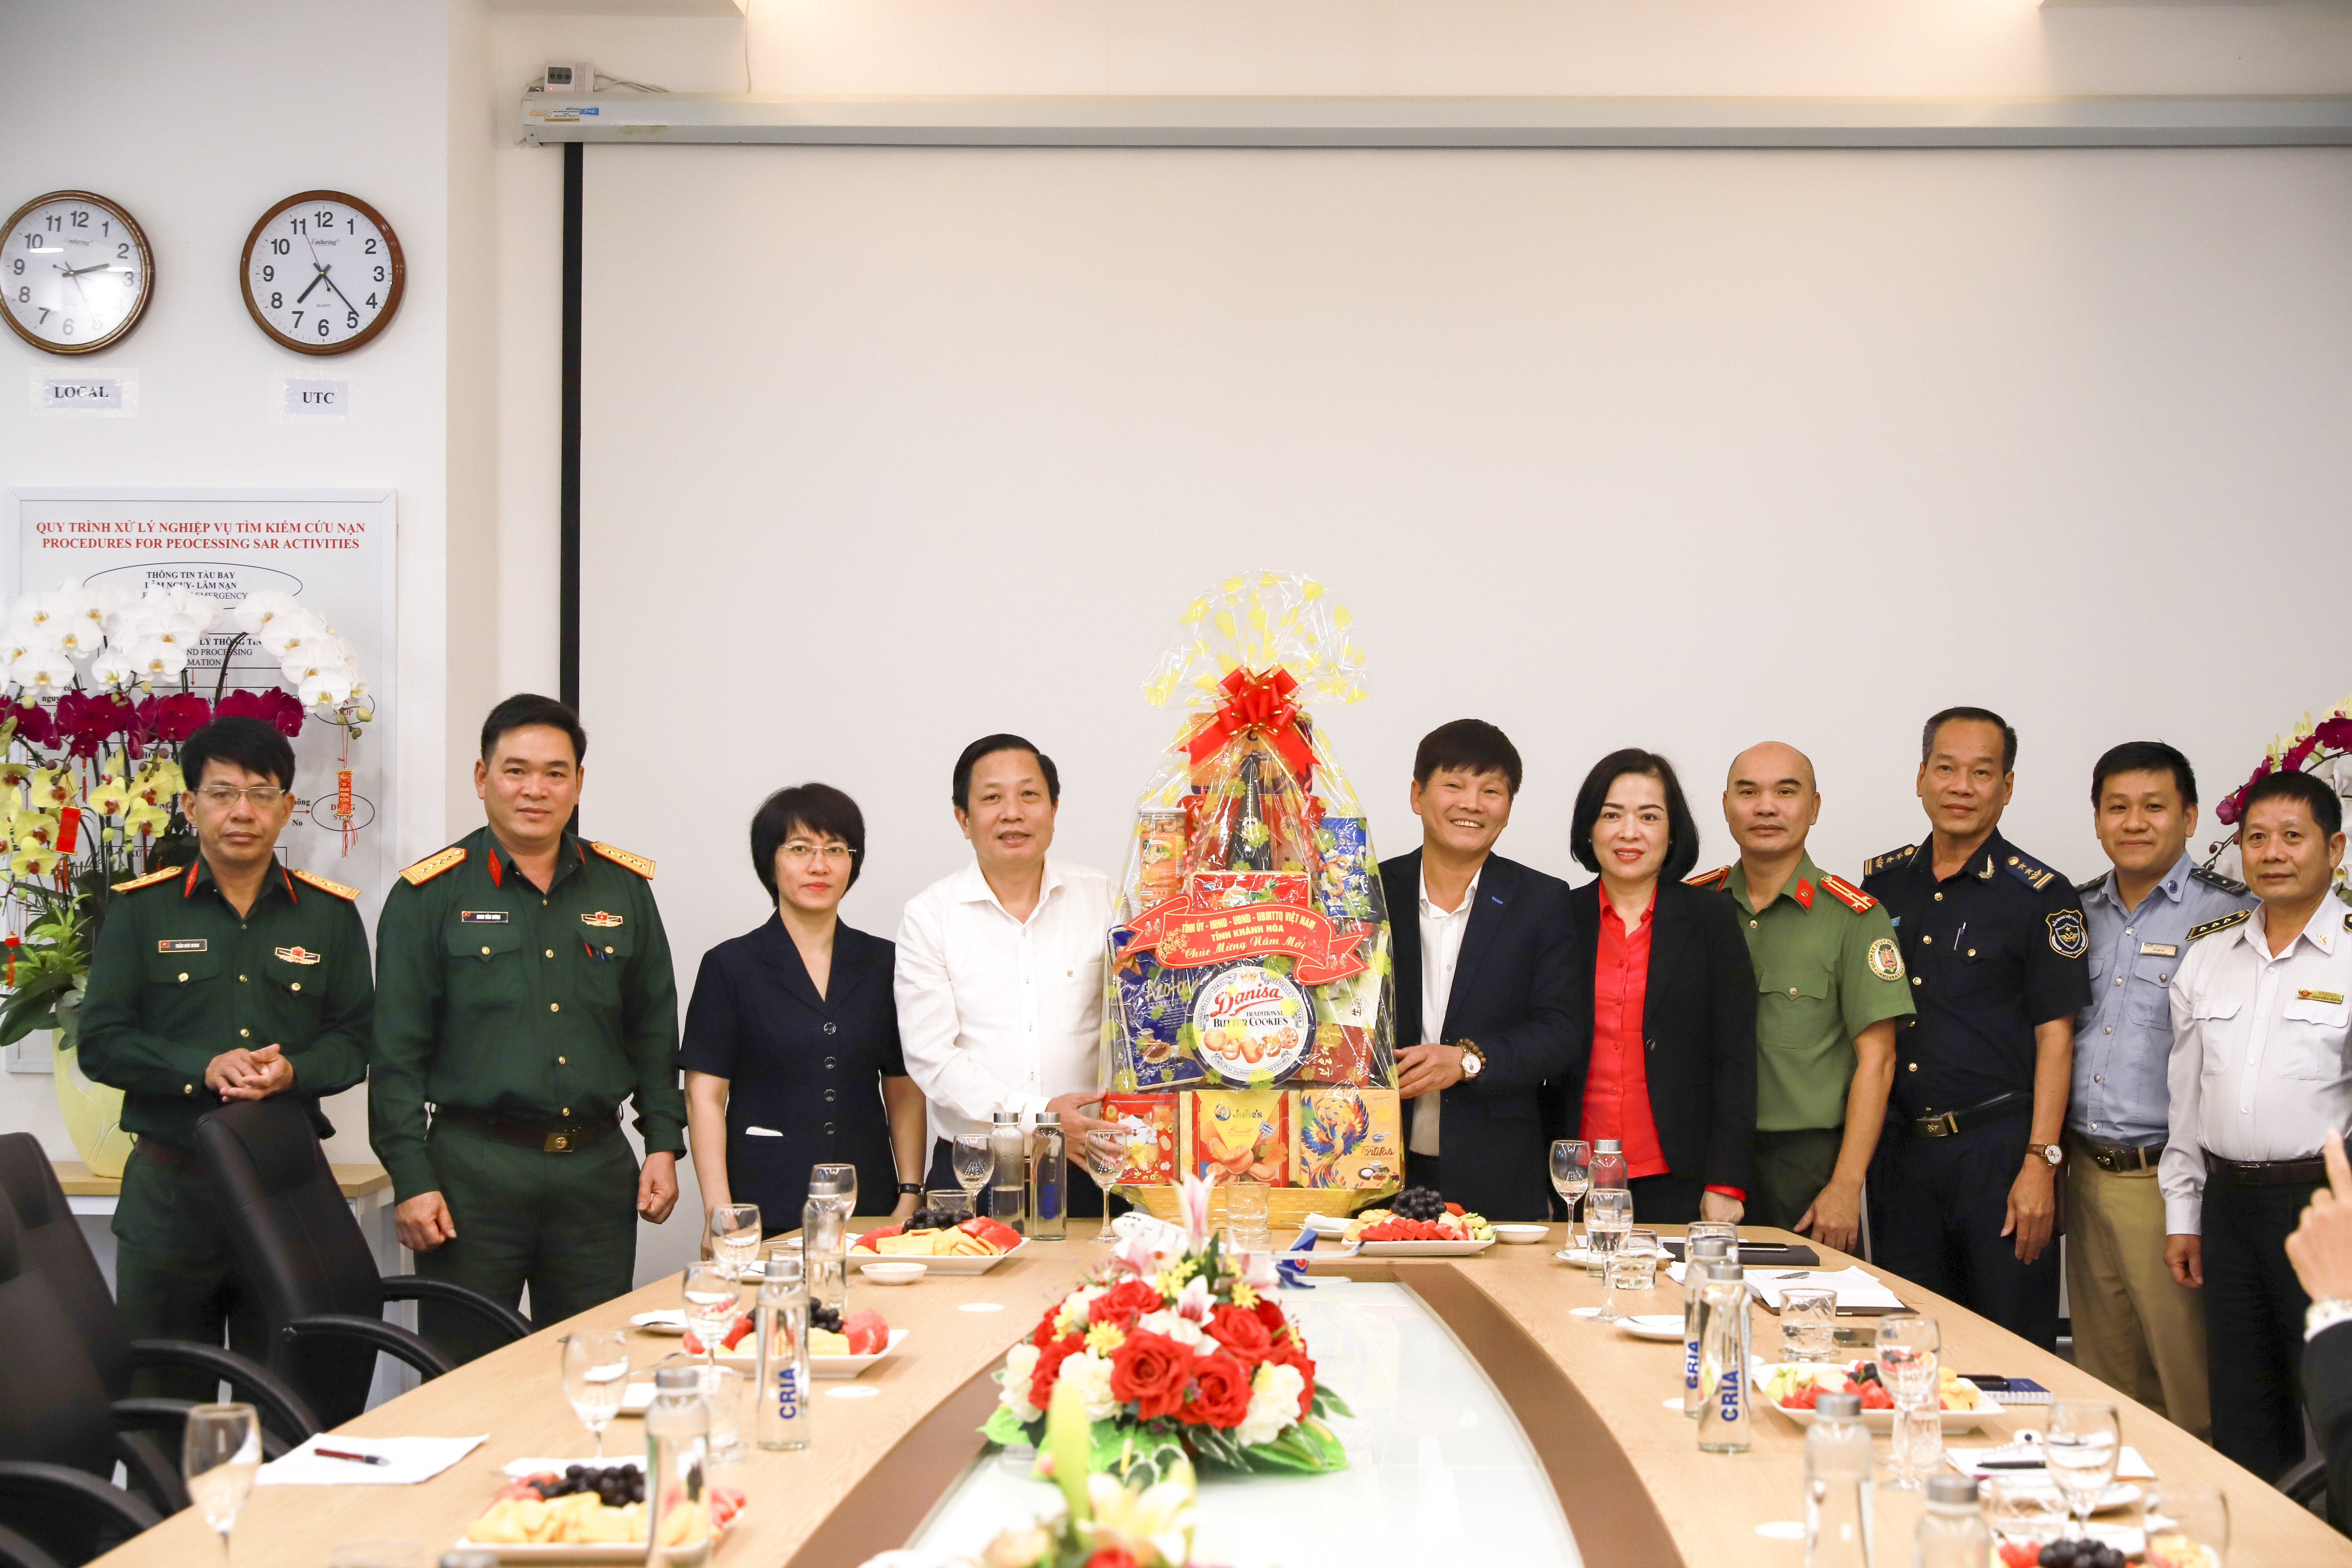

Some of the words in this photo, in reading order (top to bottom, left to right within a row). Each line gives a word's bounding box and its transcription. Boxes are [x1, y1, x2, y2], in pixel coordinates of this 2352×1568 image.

[46, 215, 61, 232] 11
[70, 211, 89, 228] 12
[291, 219, 306, 234] 11
[314, 211, 333, 227] 12
[347, 219, 354, 234] 1
[103, 221, 109, 237] 1
[25, 233, 43, 249] 10
[271, 239, 290, 254] 10
[365, 239, 376, 254] 2
[117, 243, 129, 259] 2
[14, 259, 25, 275] 9
[263, 265, 274, 282] 9
[374, 266, 384, 282] 3
[123, 272, 134, 287] 3
[19, 286, 31, 303] 8
[271, 292, 283, 309] 8
[366, 292, 377, 309] 4
[39, 307, 50, 324] 7
[92, 314, 104, 331] 5
[292, 311, 304, 328] 7
[347, 311, 358, 328] 5
[63, 318, 74, 335] 6
[318, 319, 329, 337] 6
[54, 386, 109, 399] LOCAL
[302, 392, 334, 404] UTC
[37, 522, 65, 534] QUY
[69, 519, 111, 532] TRÌNH
[115, 519, 135, 532] XỬ
[138, 519, 156, 532] LÝ
[159, 521, 210, 535] NGHIỆP
[214, 522, 232, 535] VỤ
[236, 520, 262, 533] TÌM
[265, 520, 301, 533] KIẾM
[305, 520, 333, 533] CỨU
[337, 522, 365, 535] NẠN
[43, 538, 132, 548] PROCEDURES
[136, 538, 162, 548] FOR
[166, 538, 250, 549] PEOCESSING
[253, 538, 279, 548] SAR
[283, 538, 359, 548] ACTIVITIES
[147, 570, 178, 579] THÔNG
[198, 570, 215, 579] TÀU
[1182, 920, 1195, 933] TỈNH
[1196, 919, 1204, 932] ỦY
[1210, 918, 1228, 930] HĐND
[1233, 914, 1251, 925] UBND
[1257, 911, 1283, 922] UBMTTQ
[1285, 911, 1299, 925] VIỆT
[1300, 915, 1316, 930] NAM
[1211, 931, 1231, 942] TỈNH
[1233, 925, 1263, 937] KHÁNH
[1266, 922, 1284, 933] HÒA
[1185, 947, 1211, 959] Chúc
[1214, 942, 1247, 954] Mừng
[1250, 936, 1279, 946] Năm
[1282, 936, 1306, 949] Mới
[1877, 968, 1904, 979] IMMIGRATION
[1266, 975, 1295, 998] COPENHAGEN
[1210, 983, 1283, 1017] Danisa
[1214, 1058, 1233, 1072] ORIGINAL
[1233, 1110, 1262, 1118] Julie's
[1361, 1146, 1395, 1156] Tortitas
[1686, 1340, 1700, 1389] CRIA
[779, 1367, 797, 1419] CRIA
[1721, 1369, 1739, 1422] CRIA
